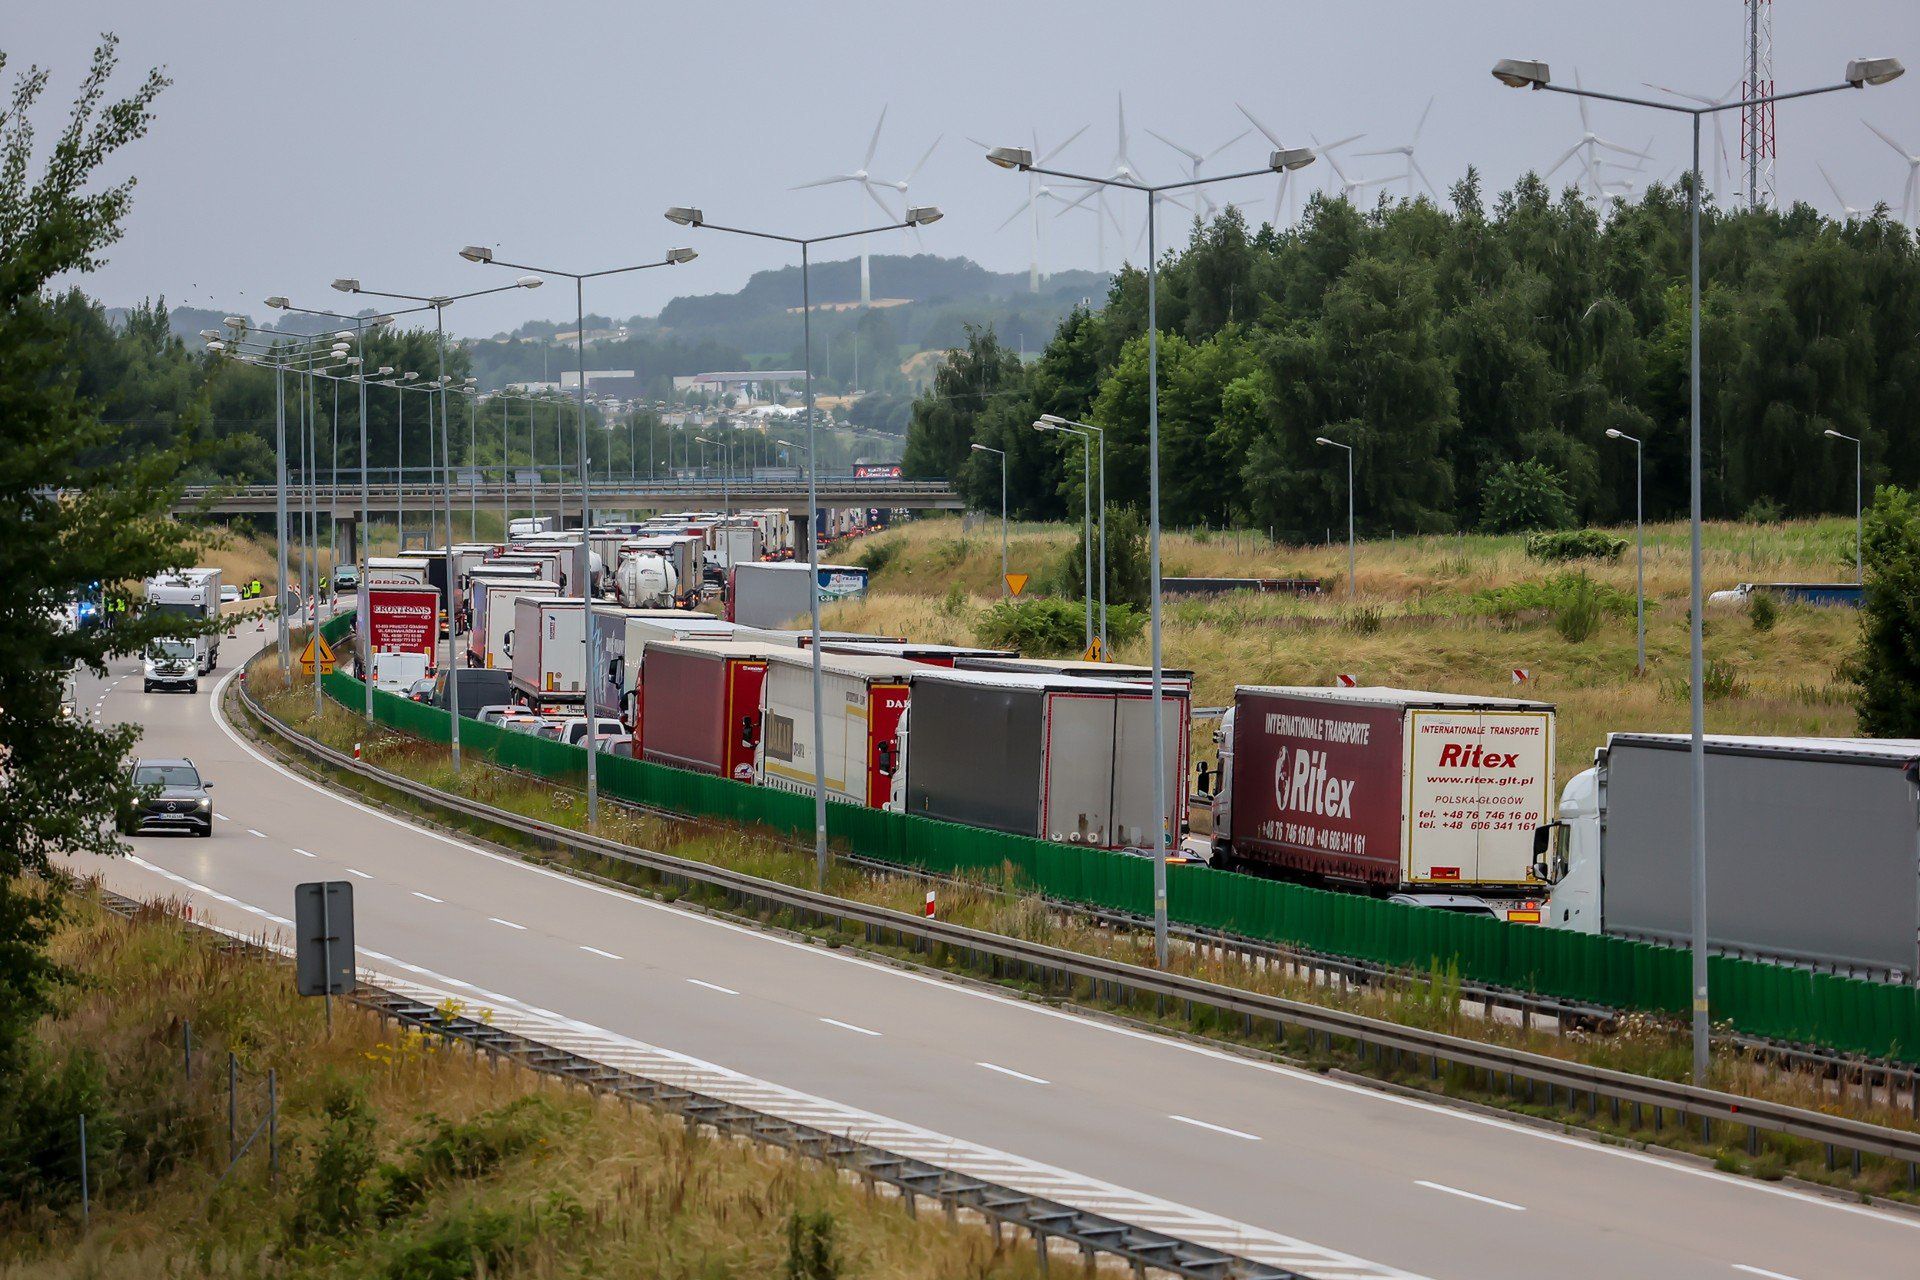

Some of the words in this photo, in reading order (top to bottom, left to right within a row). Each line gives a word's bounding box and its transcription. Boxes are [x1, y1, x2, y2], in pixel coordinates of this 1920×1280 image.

[374, 605, 431, 614] ERONTRANS
[1265, 713, 1323, 740] INTERNATIONALE
[1324, 721, 1370, 745] TRANSPORTE
[1421, 725, 1486, 735] INTERNATIONALE
[1490, 726, 1540, 736] TRANSPORTE
[1439, 743, 1520, 768] Ritex
[1290, 749, 1355, 818] Ritex
[1427, 776, 1534, 786] www.ritex.glt.pl
[1419, 810, 1436, 819] tel.
[1442, 810, 1463, 819] +48
[1466, 811, 1479, 819] 76
[1485, 811, 1505, 820] 746
[1508, 811, 1521, 820] 16
[1525, 811, 1538, 820] 00
[1419, 820, 1436, 829] tel.
[1442, 821, 1463, 830] +48
[1471, 821, 1490, 830] 606
[1494, 822, 1512, 830] 341
[1517, 822, 1536, 831] 161
